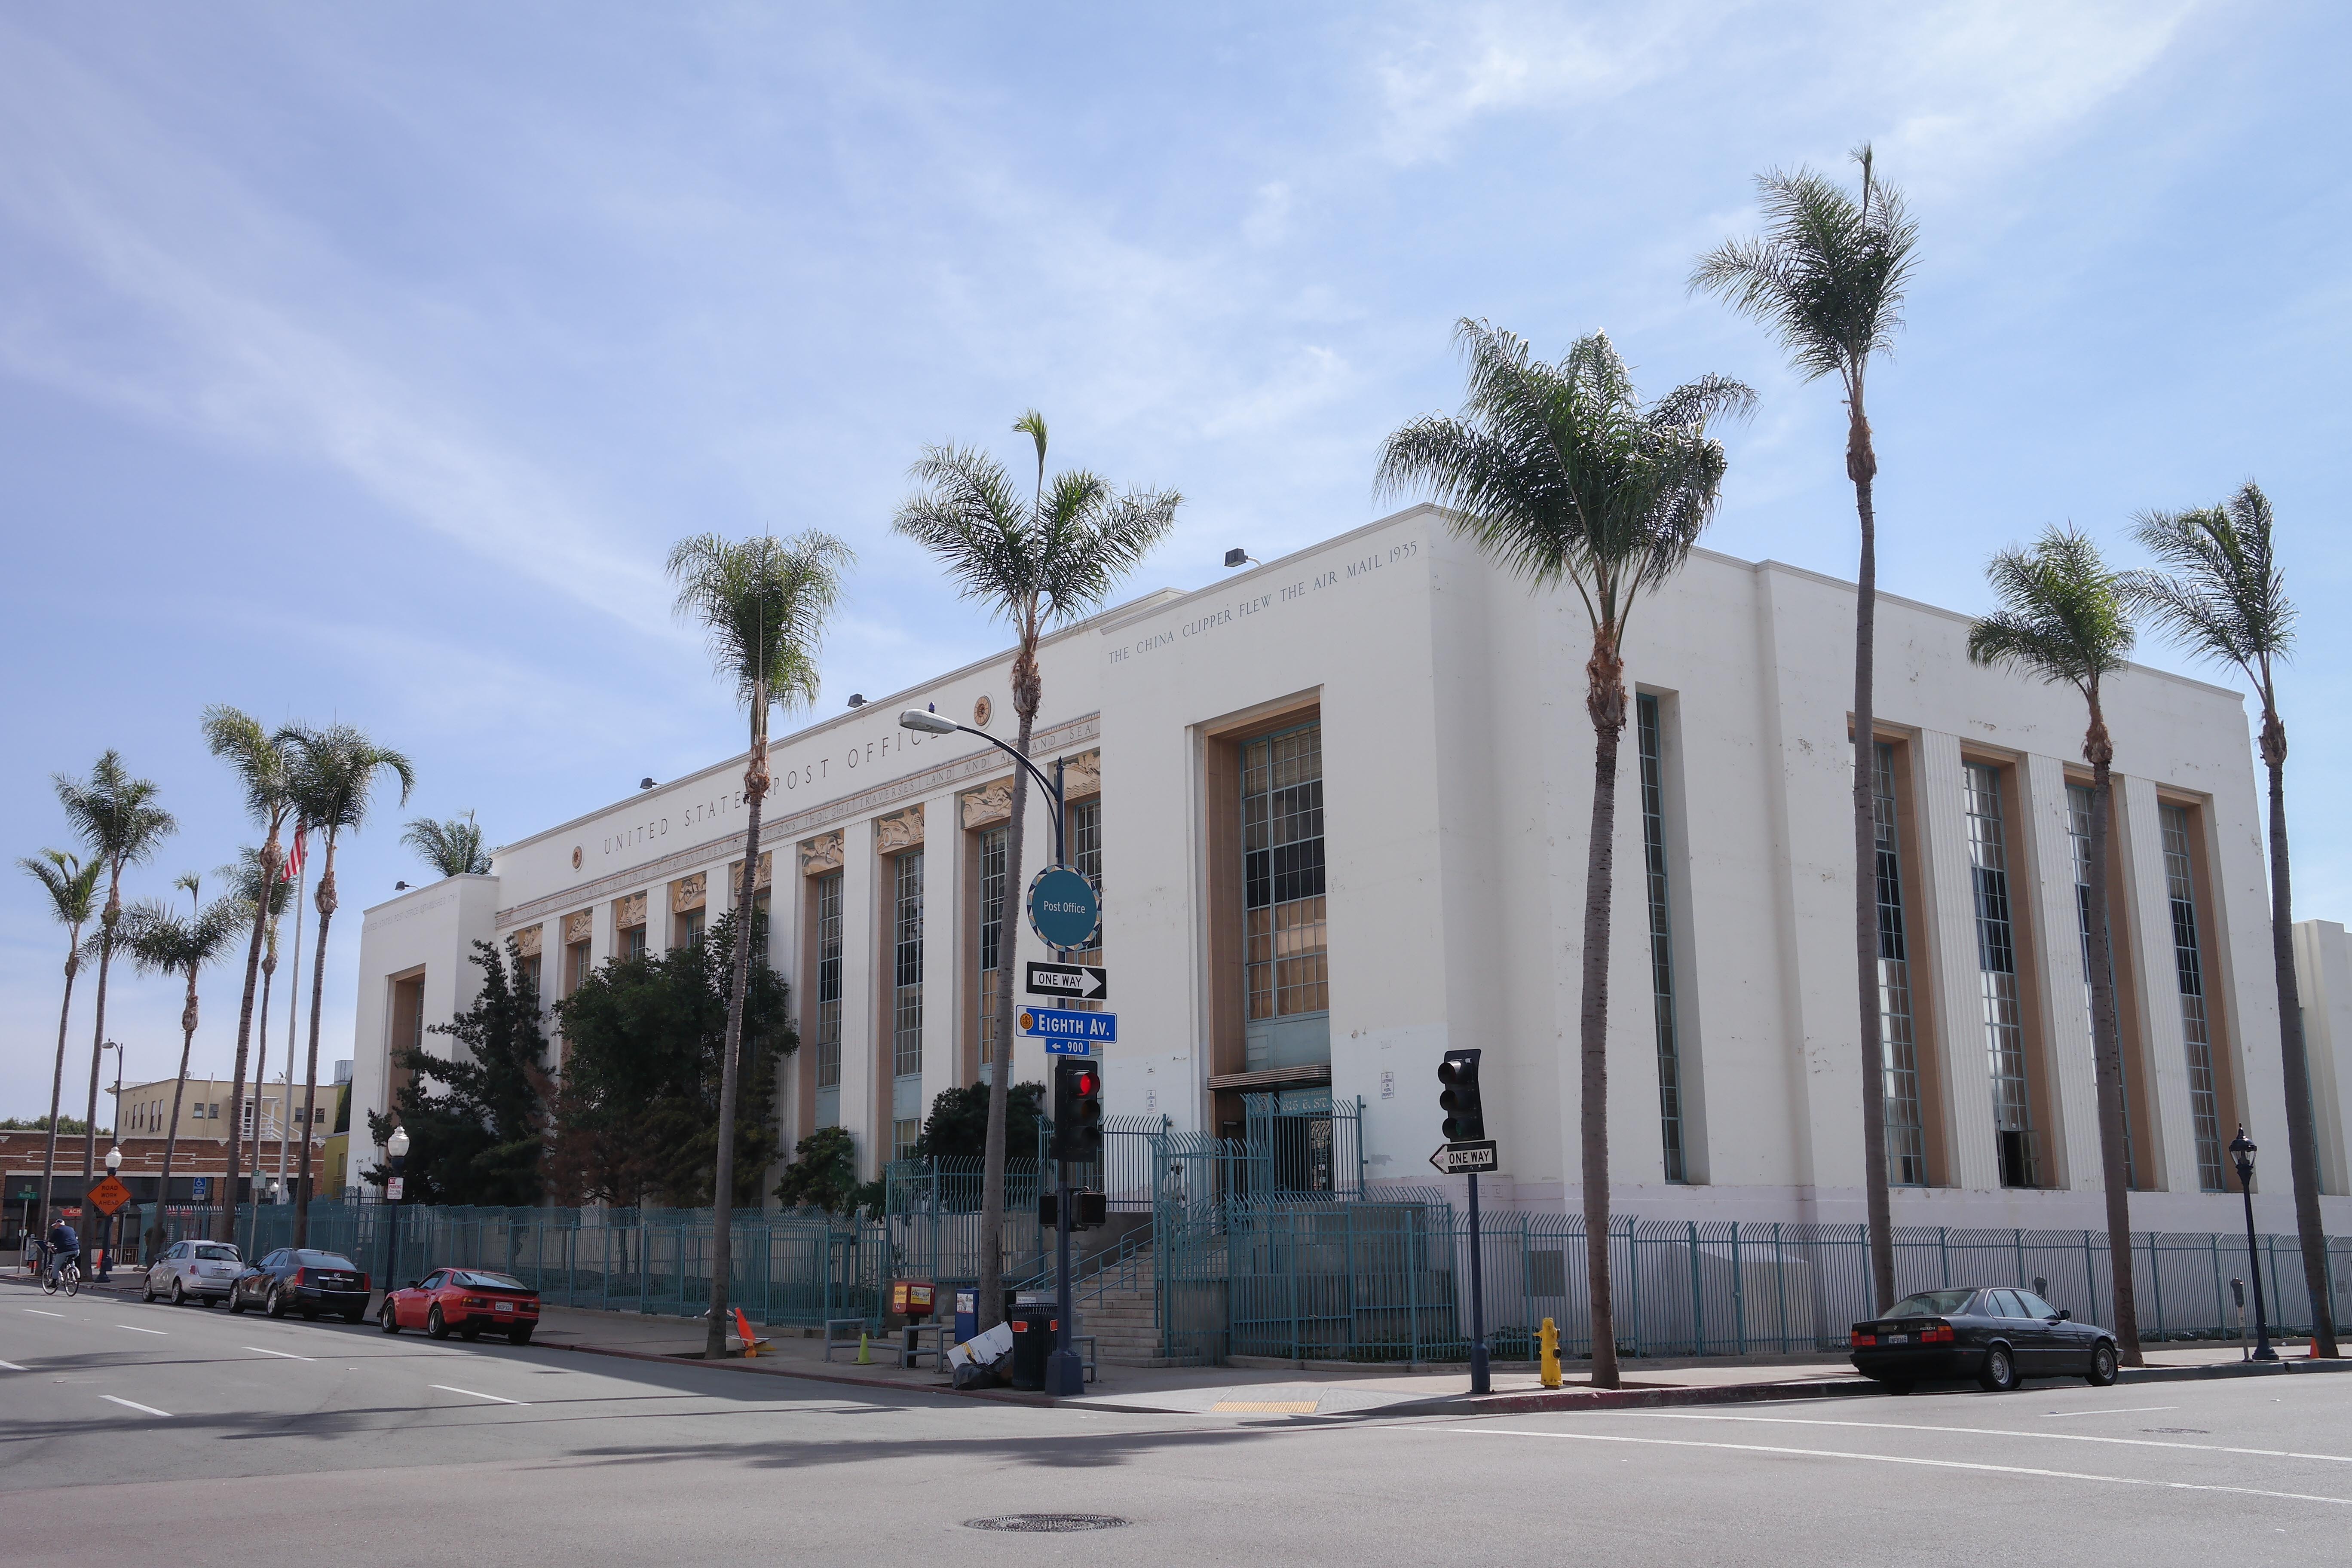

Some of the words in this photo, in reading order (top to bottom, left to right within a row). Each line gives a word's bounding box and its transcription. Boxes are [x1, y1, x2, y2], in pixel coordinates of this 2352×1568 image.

[1109, 646, 1129, 664] THE
[1136, 631, 1174, 654] CHINA
[1183, 609, 1232, 637] CLIPPER
[1239, 594, 1272, 617] FLEW
[1280, 582, 1305, 602] THE
[1313, 571, 1338, 591] AIR
[1347, 554, 1382, 579] MAIL
[1390, 540, 1417, 563] 1935
[589, 886, 601, 896] AND
[609, 879, 622, 888] THE
[629, 872, 645, 881] TOIL
[652, 865, 660, 875] OF
[668, 852, 699, 870] PATIENT
[708, 845, 723, 857] MEN
[732, 837, 747, 849] THE
[805, 802, 849, 826] THOUGHT
[860, 781, 914, 807] TRAVERSES
[926, 769, 952, 786] LAND
[965, 759, 986, 773] AND
[1032, 735, 1056, 750] AND
[1070, 724, 1091, 739] SEA
[604, 818, 669, 854] UNITED
[685, 790, 741, 827] STATE
[774, 759, 829, 798] POST
[1044, 901, 1060, 912] Post
[1063, 902, 1085, 913] Office
[1038, 973, 1058, 986] ONE
[1063, 975, 1081, 987] WAY
[1038, 1014, 1084, 1034] EIGHTH
[1067, 1041, 1084, 1053] 900
[1283, 1100, 1298, 1111] 815
[1449, 1152, 1468, 1164] ONE
[1471, 1151, 1489, 1162] WAY
